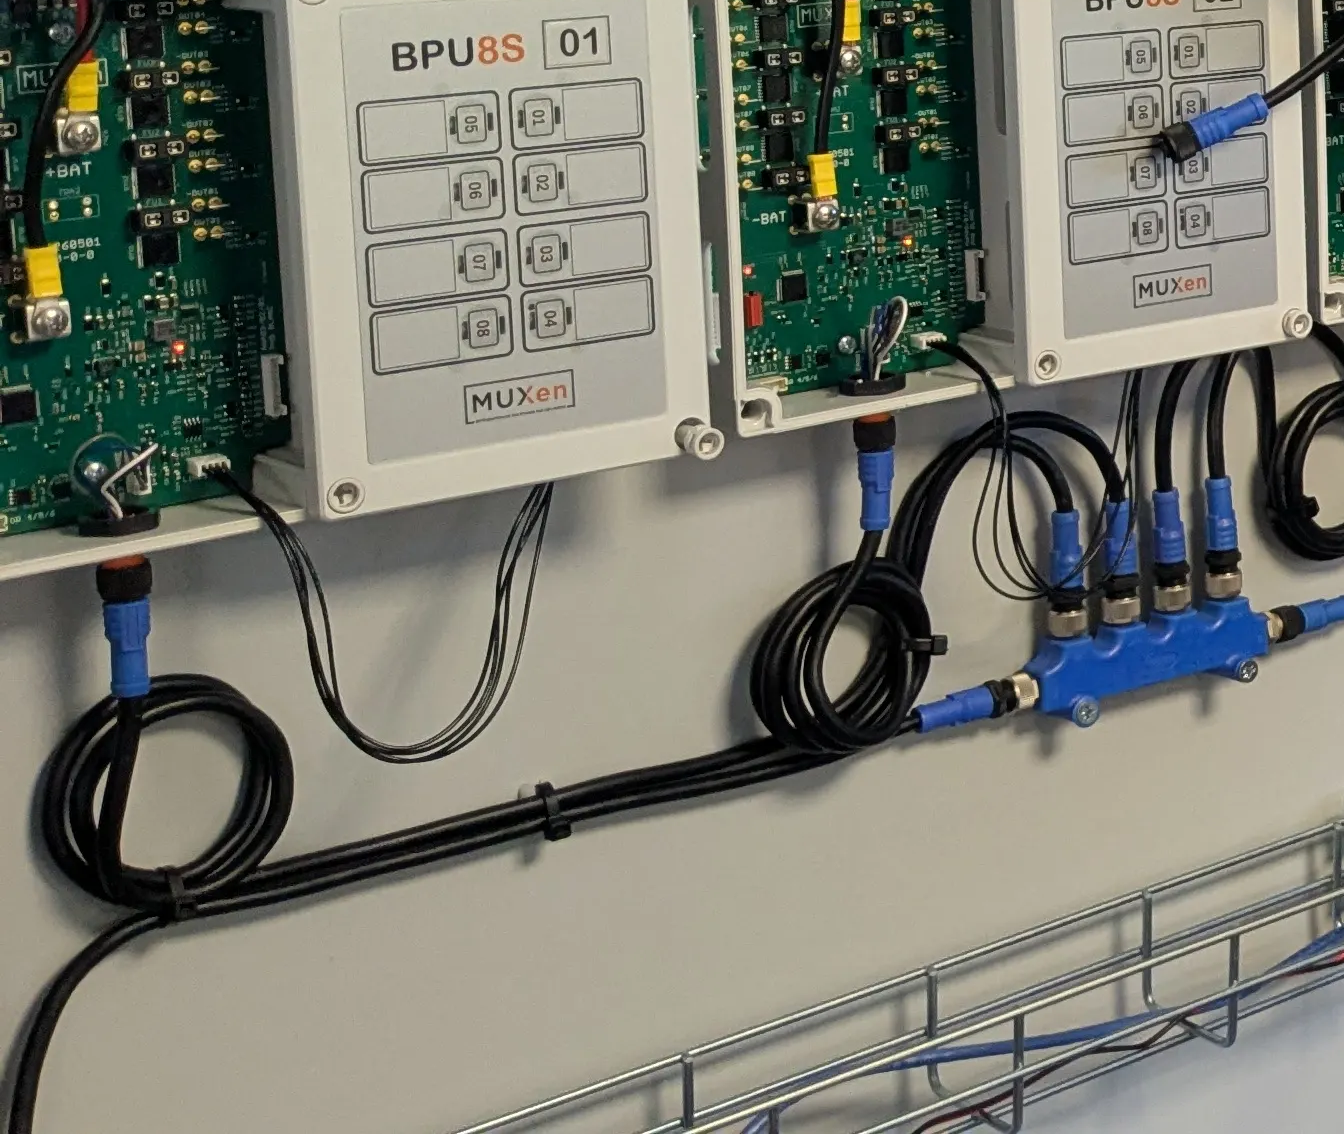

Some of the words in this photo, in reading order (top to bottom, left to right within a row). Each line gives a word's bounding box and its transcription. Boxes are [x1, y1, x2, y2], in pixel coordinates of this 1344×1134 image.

[801, 7, 832, 24] MUX
[391, 33, 525, 72] BPU8S
[559, 26, 598, 57] 01
[1136, 50, 1146, 64] 05
[1184, 45, 1194, 58] 01
[1138, 104, 1148, 120] 06
[1186, 99, 1196, 114] 02
[464, 115, 478, 134] 05
[532, 109, 545, 126] 01
[45, 161, 92, 177] +BAT
[1141, 166, 1150, 180] 07
[1189, 159, 1198, 174] 03
[469, 181, 482, 200] 06
[536, 174, 549, 192] 02
[752, 210, 787, 225] -BAT
[1190, 214, 1200, 229] 04
[1142, 221, 1152, 236] 08
[472, 254, 486, 271] 07
[540, 245, 554, 263] 03
[1139, 276, 1207, 299] MUXen
[543, 310, 558, 328] 04
[476, 319, 490, 338] 08
[472, 382, 568, 413] MUXen
